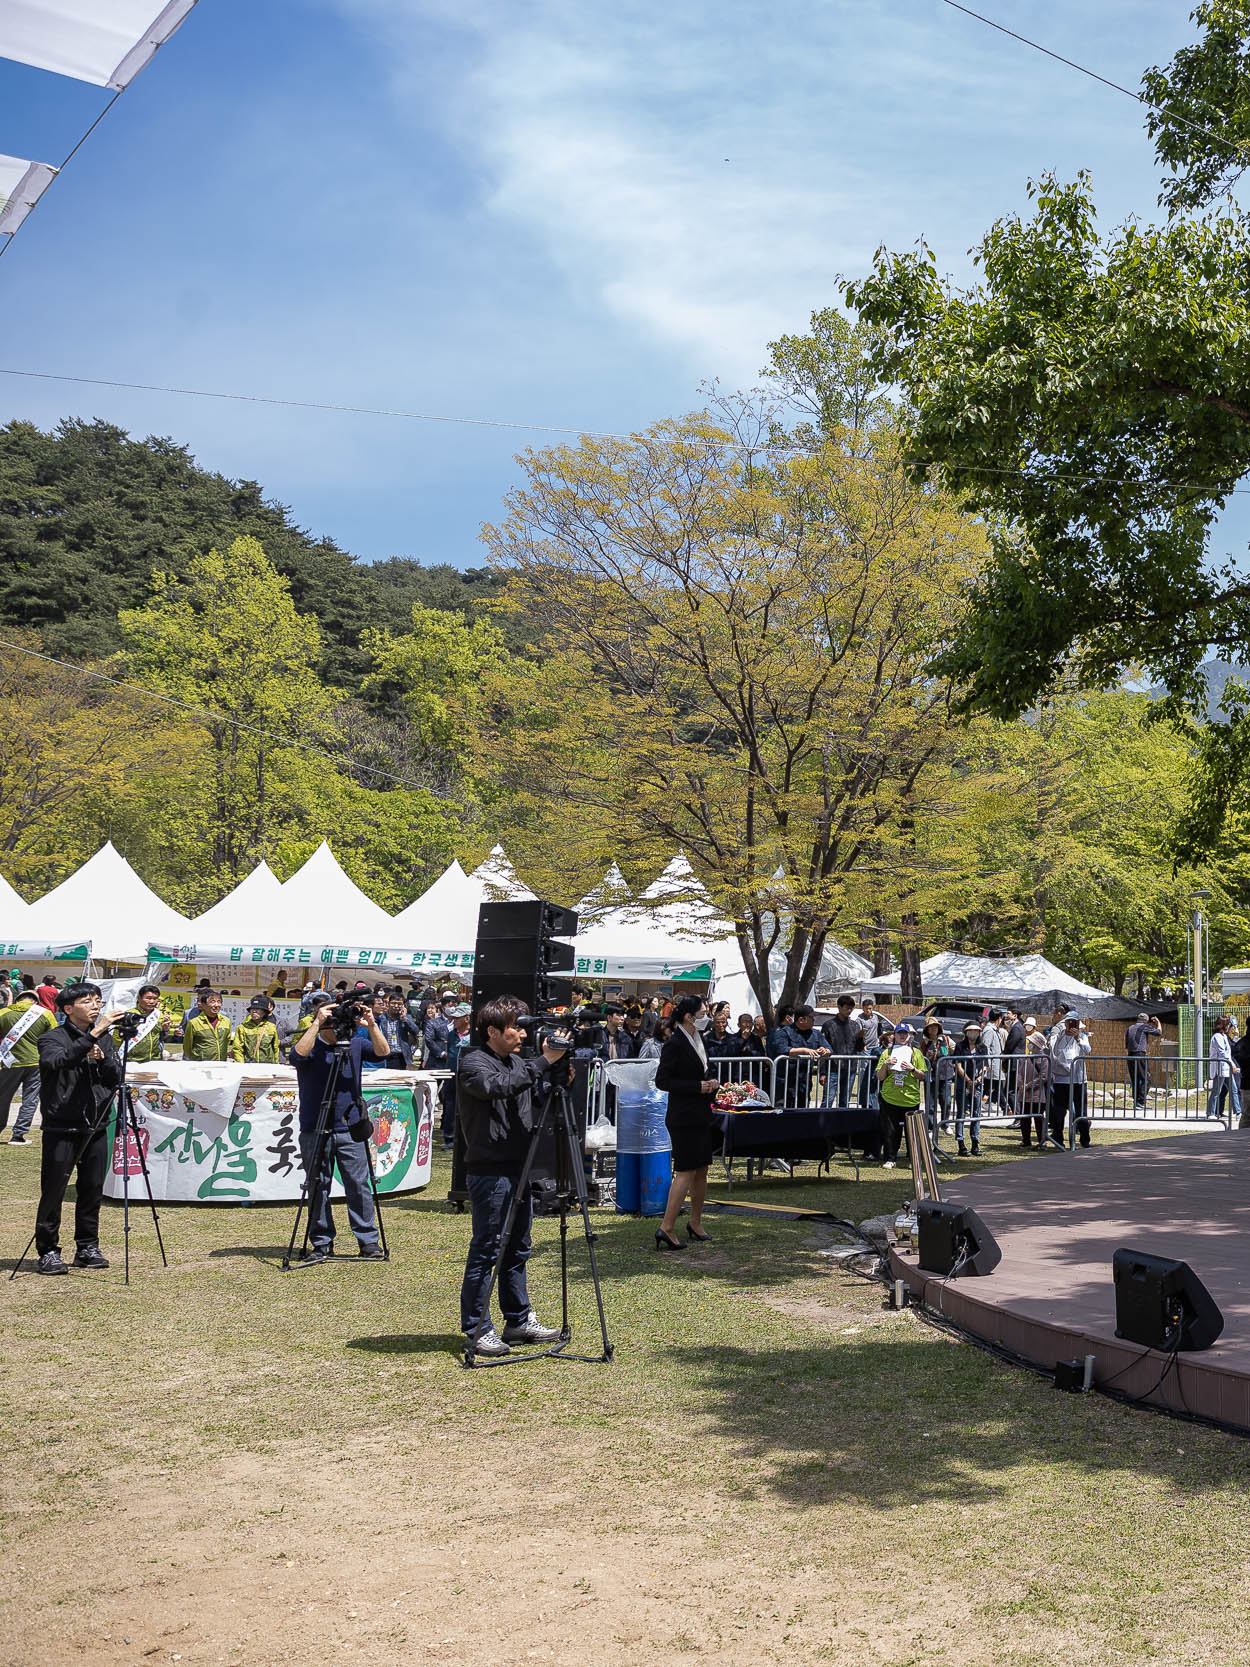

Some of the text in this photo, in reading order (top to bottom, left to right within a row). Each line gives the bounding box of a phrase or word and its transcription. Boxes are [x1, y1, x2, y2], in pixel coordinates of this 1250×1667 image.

[230, 947, 243, 961] 밥
[251, 947, 311, 963] 잘해주는
[320, 949, 350, 964] 예쁜
[357, 951, 387, 965] 엄마
[568, 958, 608, 974] 합회
[154, 1114, 258, 1199] 산나물
